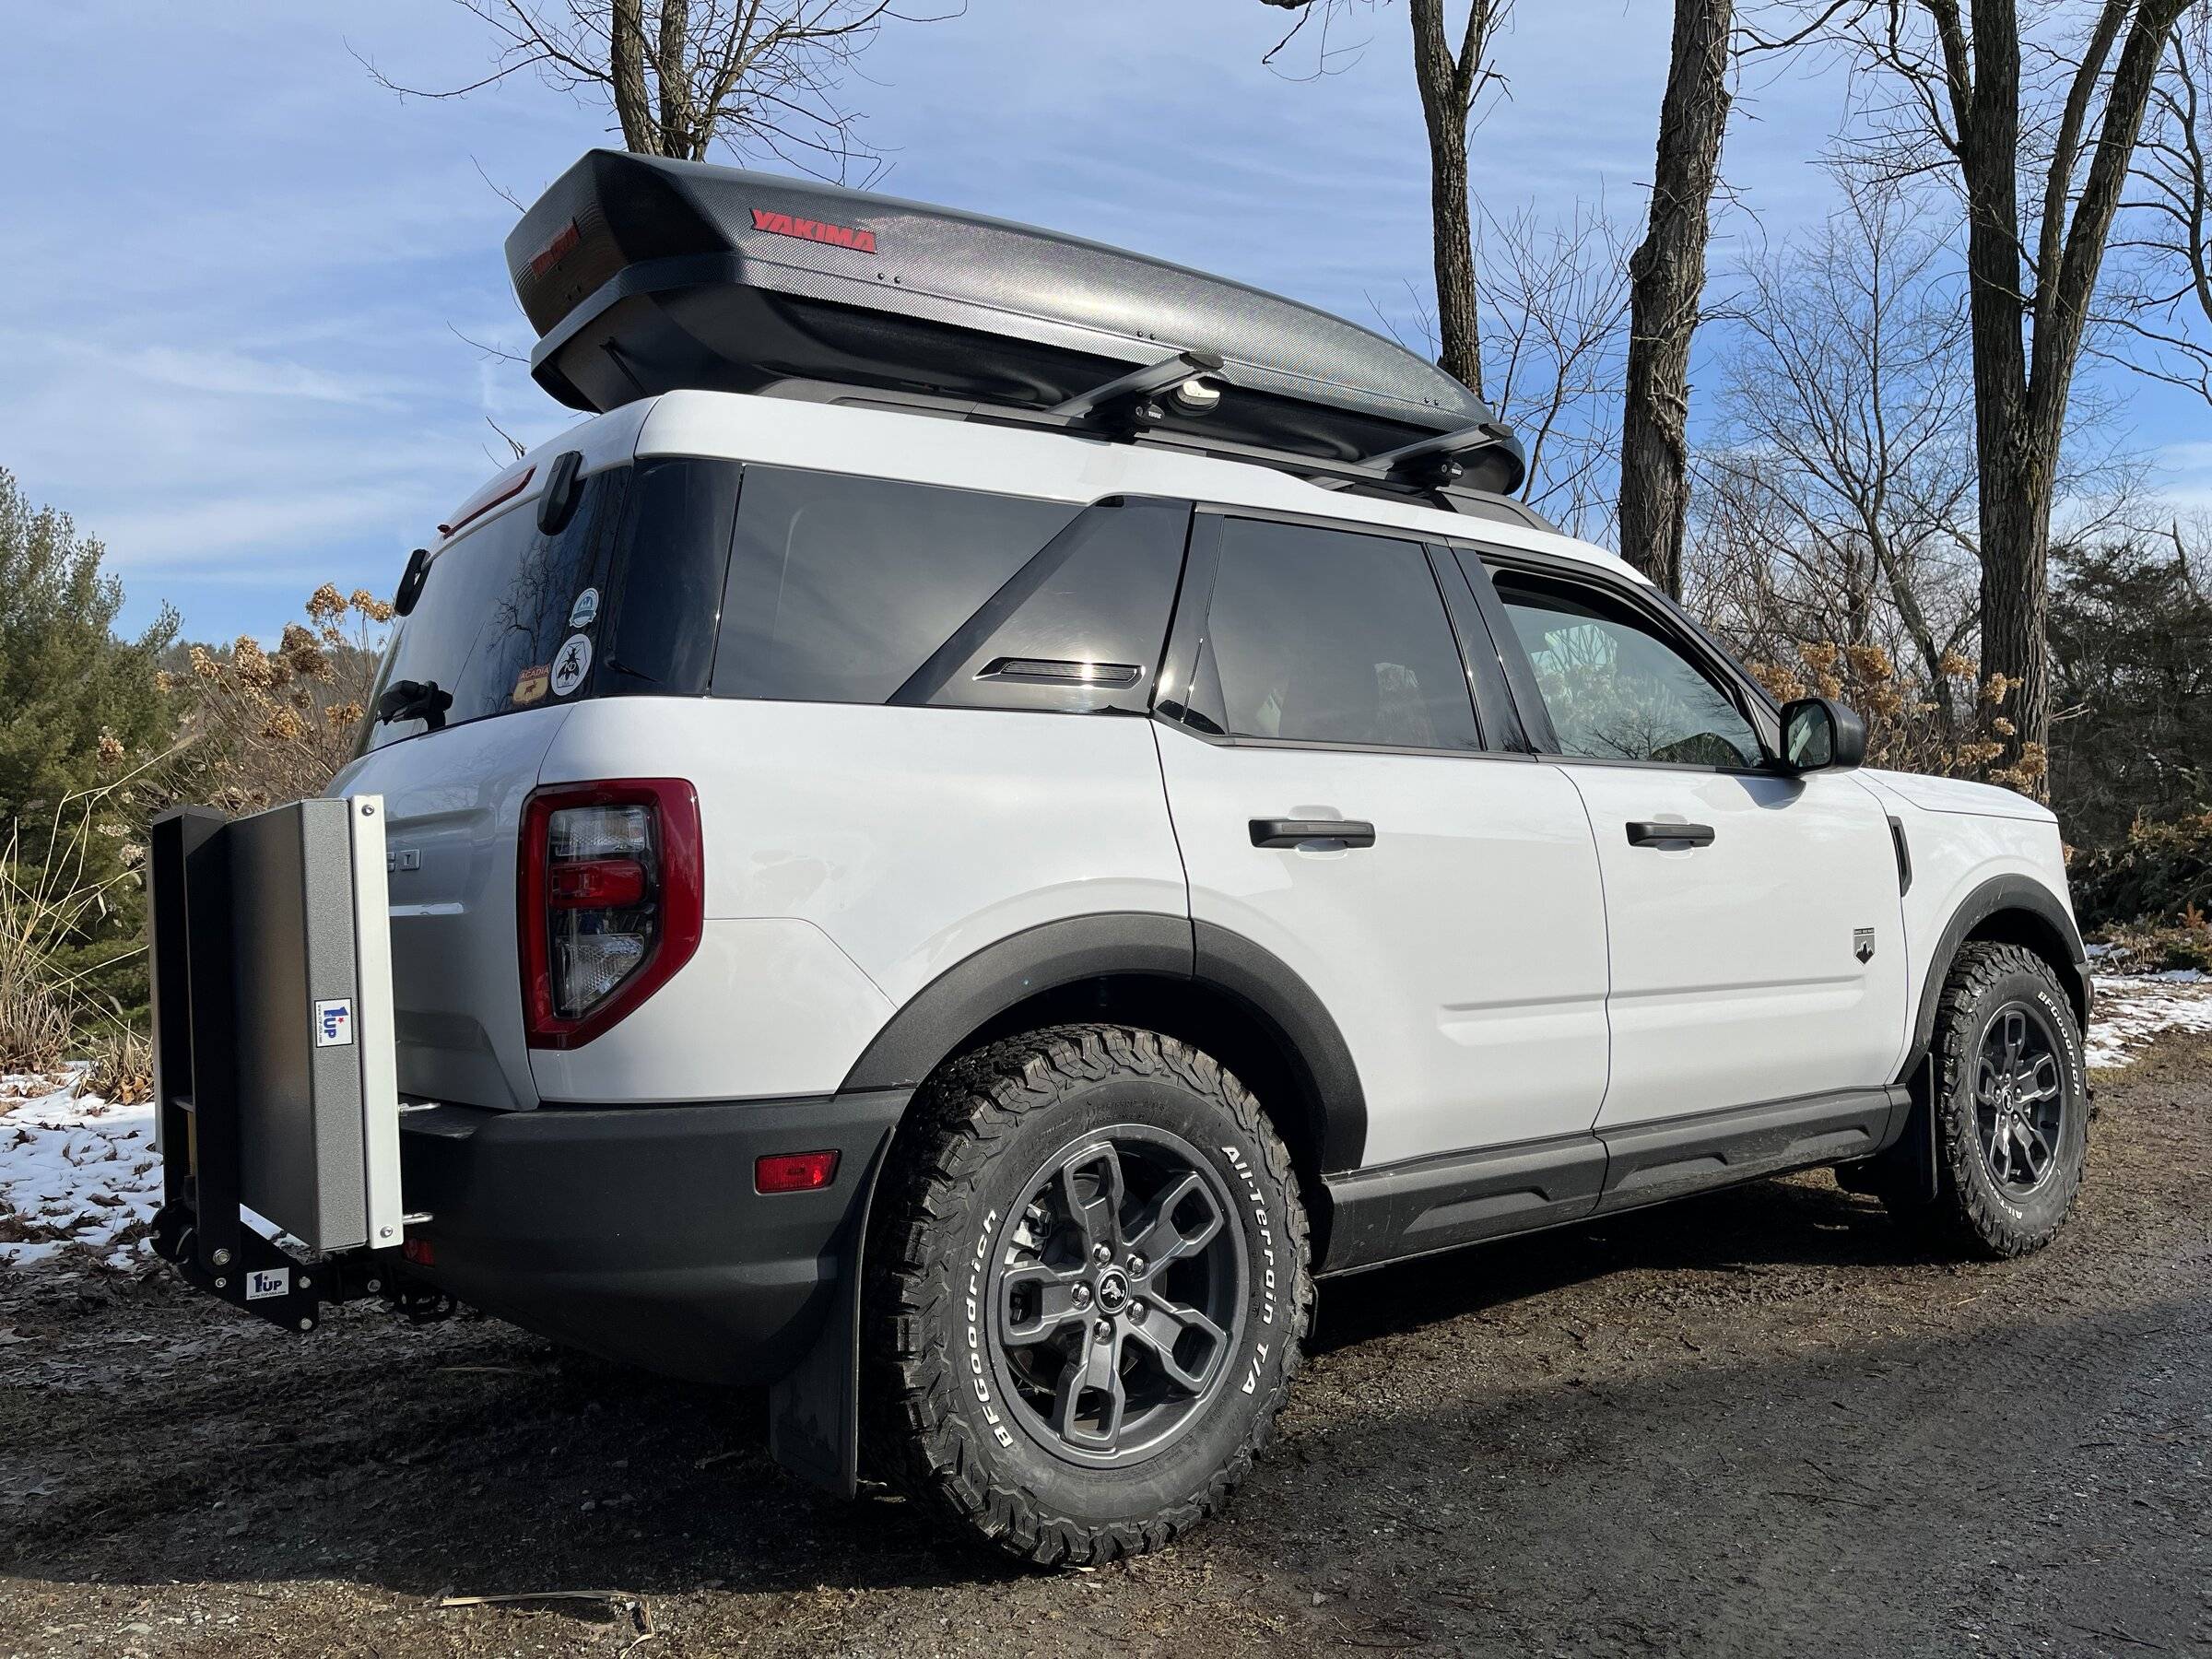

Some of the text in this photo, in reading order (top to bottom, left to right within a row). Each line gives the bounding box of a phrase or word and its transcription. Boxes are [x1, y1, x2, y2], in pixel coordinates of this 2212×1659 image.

[752, 208, 877, 252] YAKIMA
[520, 666, 549, 679] ACADIA
[324, 1006, 349, 1039] 1UP
[2037, 991, 2079, 1096] BFGoodrich
[253, 1273, 283, 1293] 1UP
[1221, 1147, 1277, 1395] All-Terrain T/A
[966, 1209, 1014, 1448] BFGoodrich
